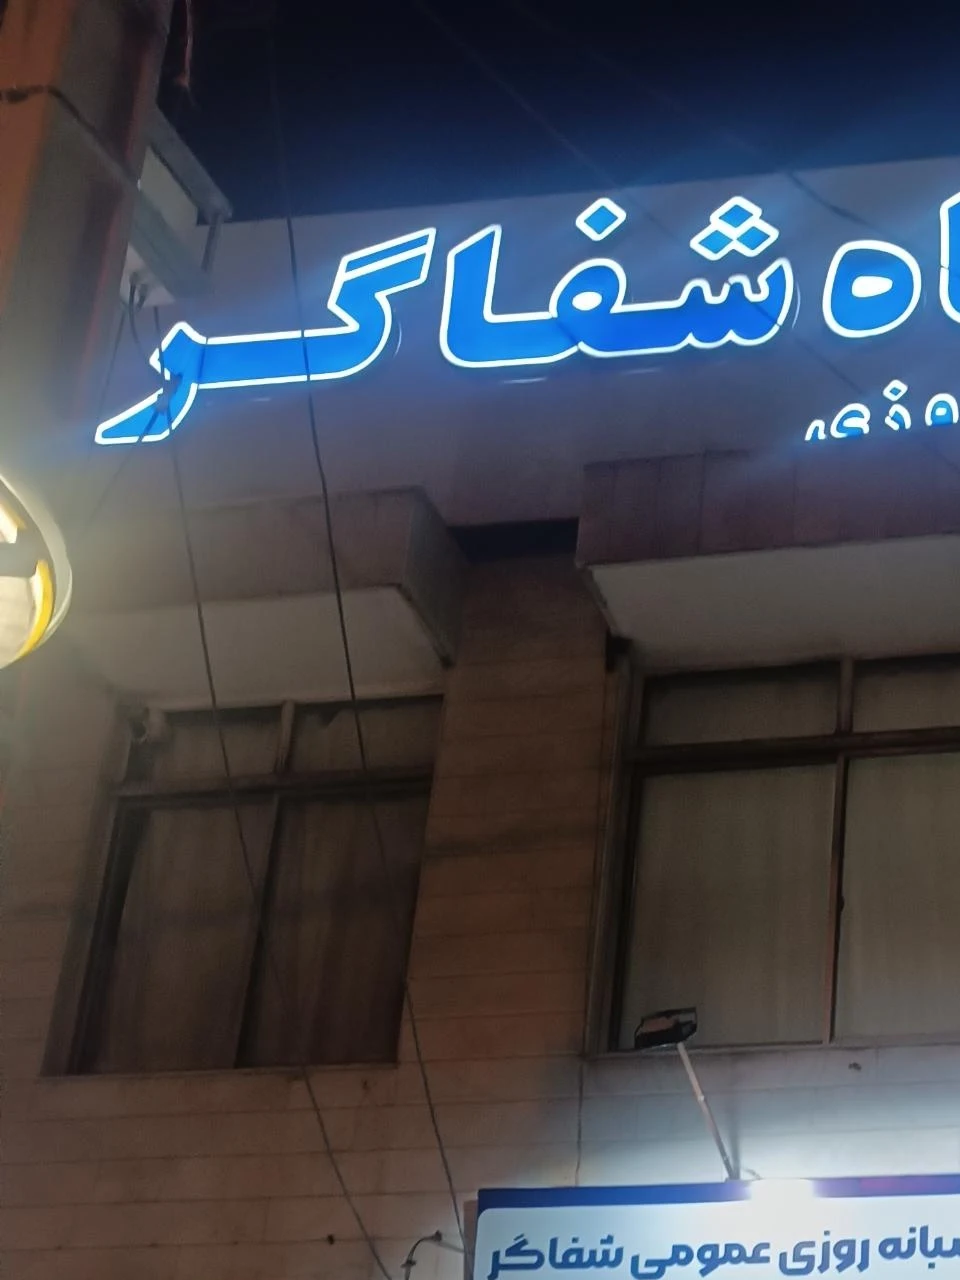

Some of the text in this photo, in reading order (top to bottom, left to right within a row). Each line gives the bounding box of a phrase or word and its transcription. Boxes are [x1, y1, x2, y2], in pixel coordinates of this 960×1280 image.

[95, 196, 793, 445] شفاگر
[631, 1242, 770, 1280] عمومی
[779, 1230, 870, 1275] روزی
